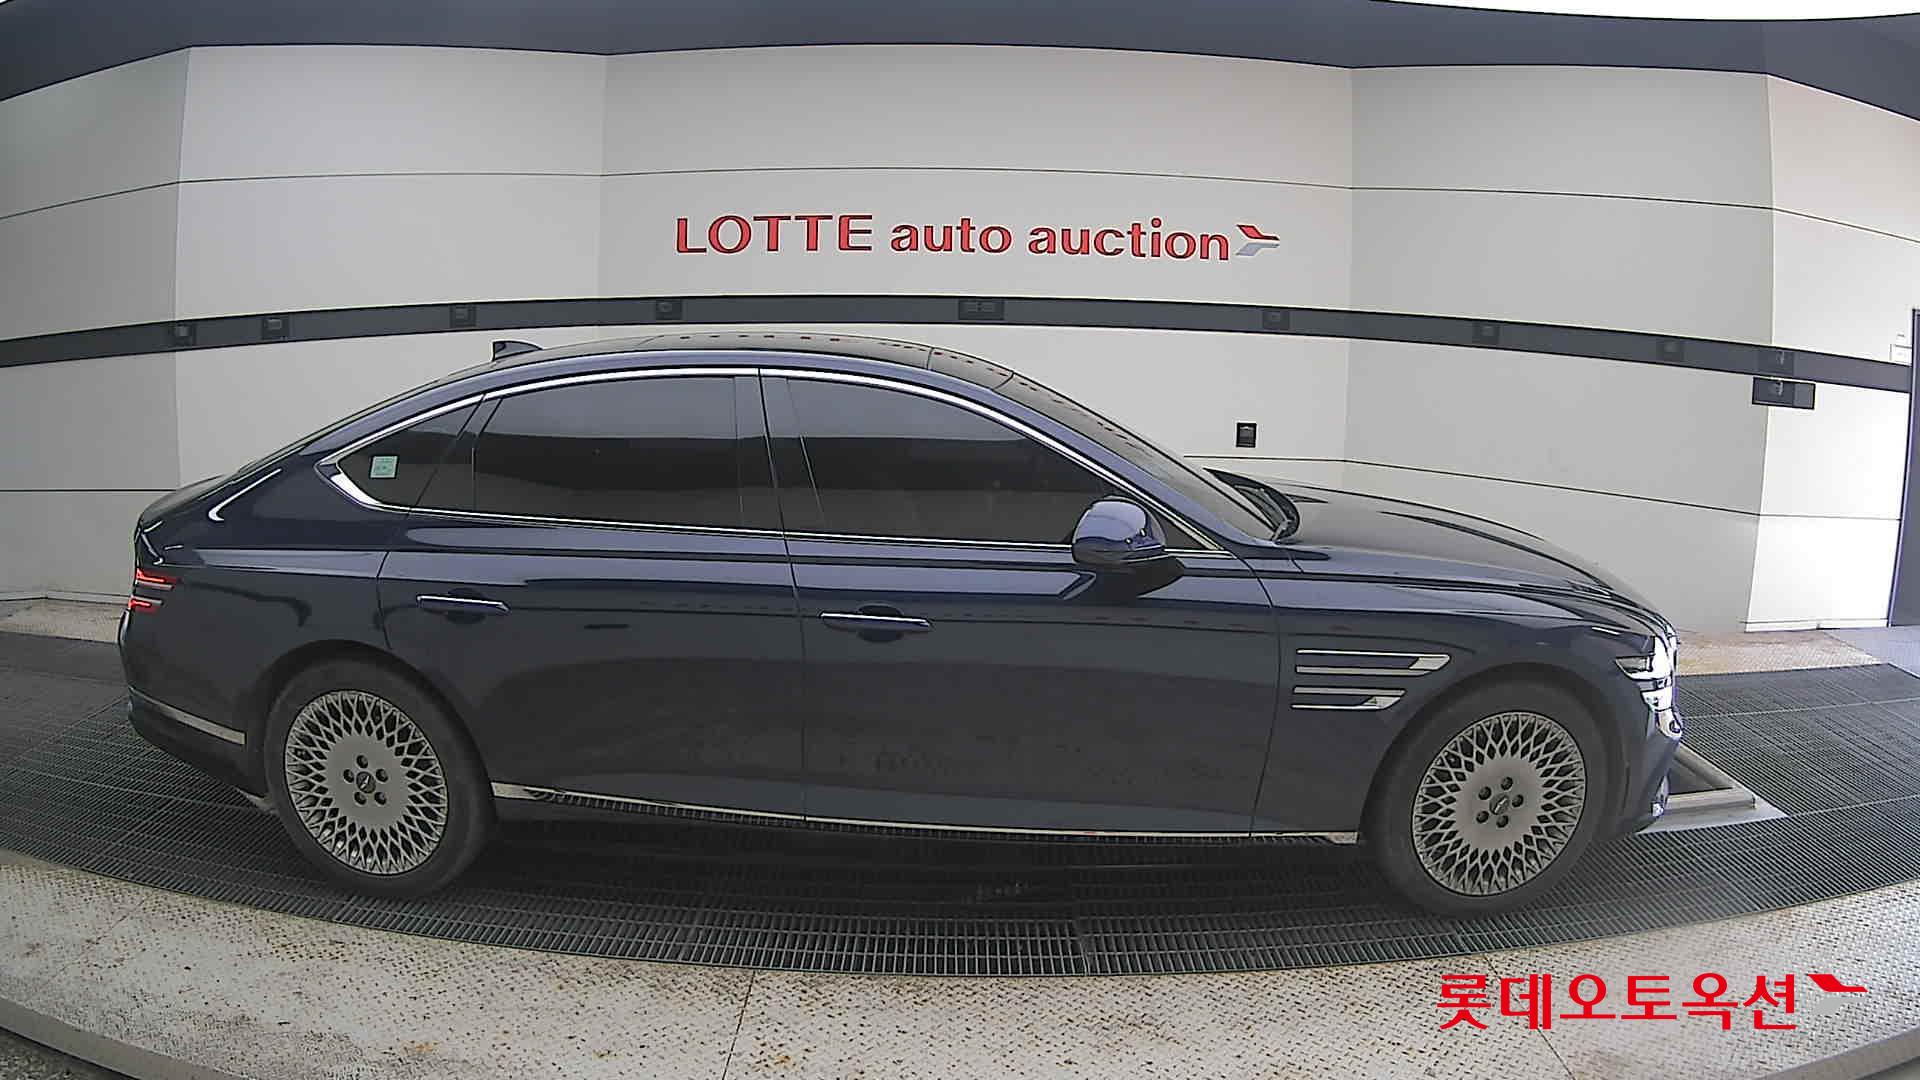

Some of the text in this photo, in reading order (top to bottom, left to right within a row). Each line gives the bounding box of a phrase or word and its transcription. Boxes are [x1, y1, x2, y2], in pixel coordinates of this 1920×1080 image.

[675, 214, 1230, 260] LOTTE auto auction
